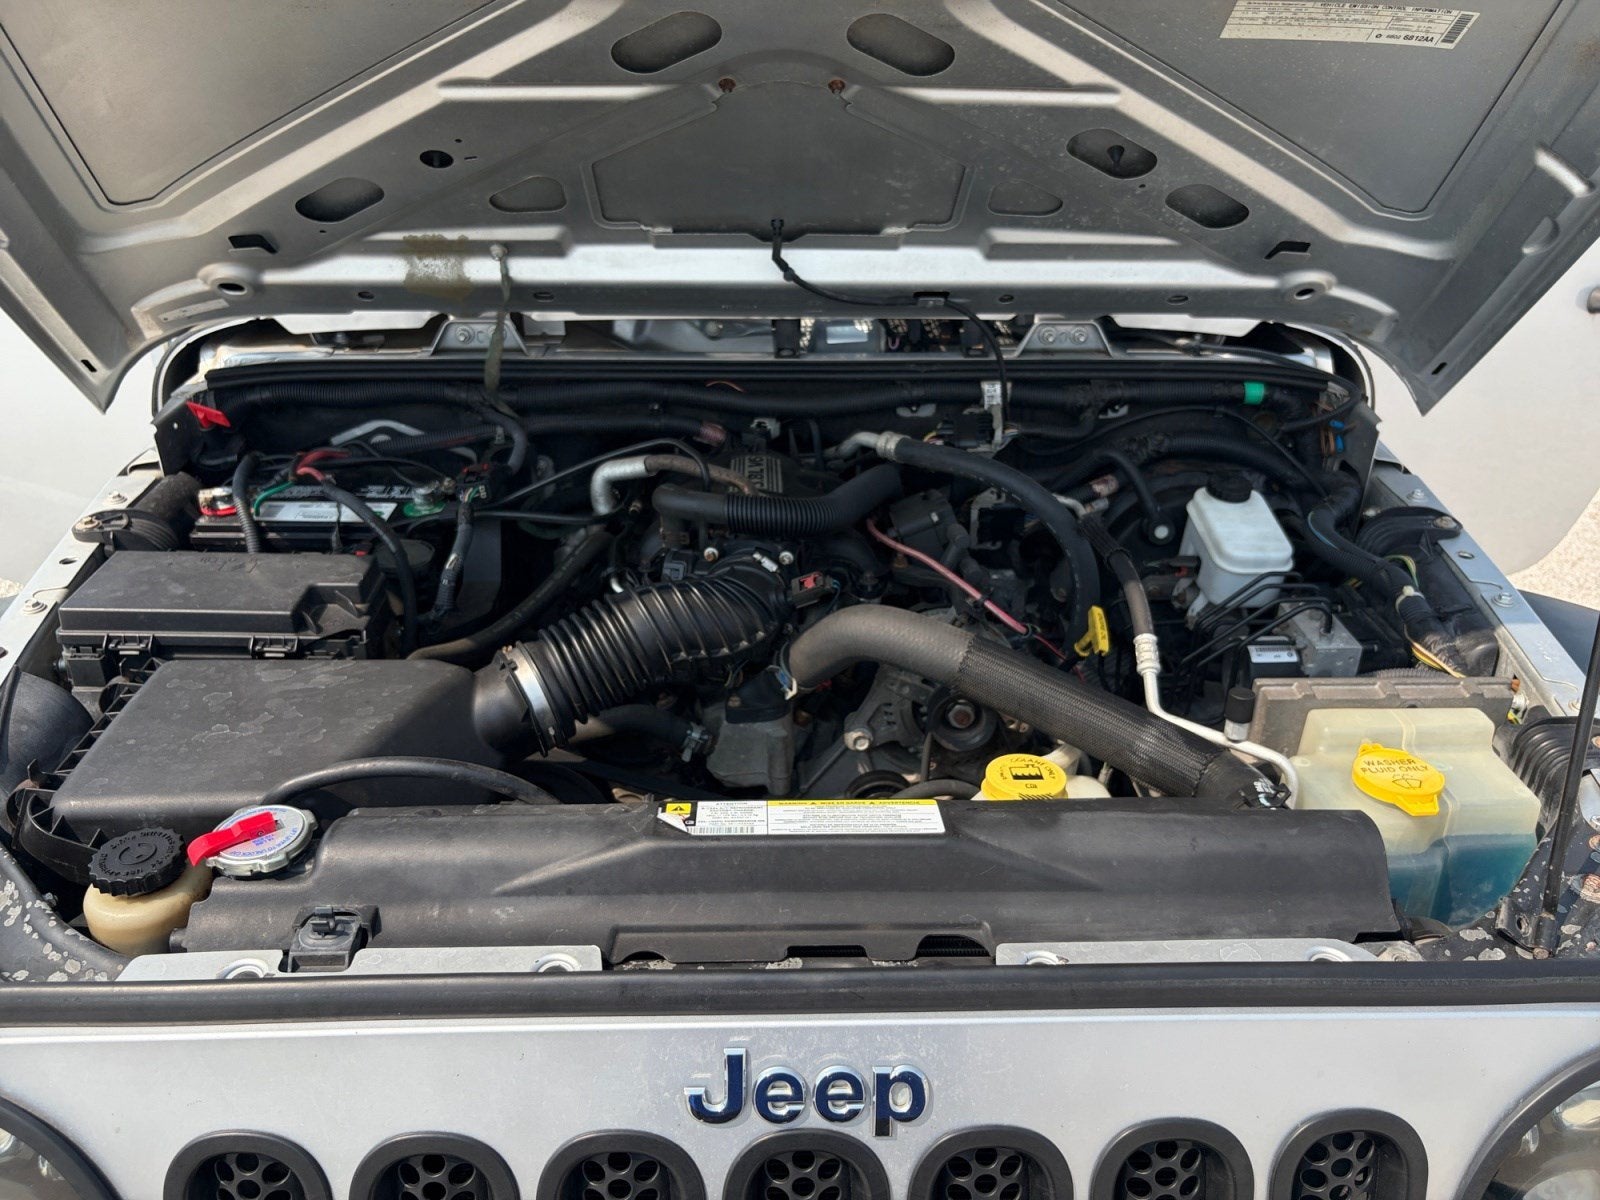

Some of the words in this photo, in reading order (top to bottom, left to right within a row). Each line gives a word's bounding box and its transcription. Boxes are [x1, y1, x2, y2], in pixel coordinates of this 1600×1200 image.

[1403, 34, 1435, 43] 6812AA
[1363, 758, 1416, 767] WASHER
[1360, 766, 1396, 774] FLUID
[1399, 765, 1430, 773] ONLY
[683, 1047, 930, 1138] Jeep
